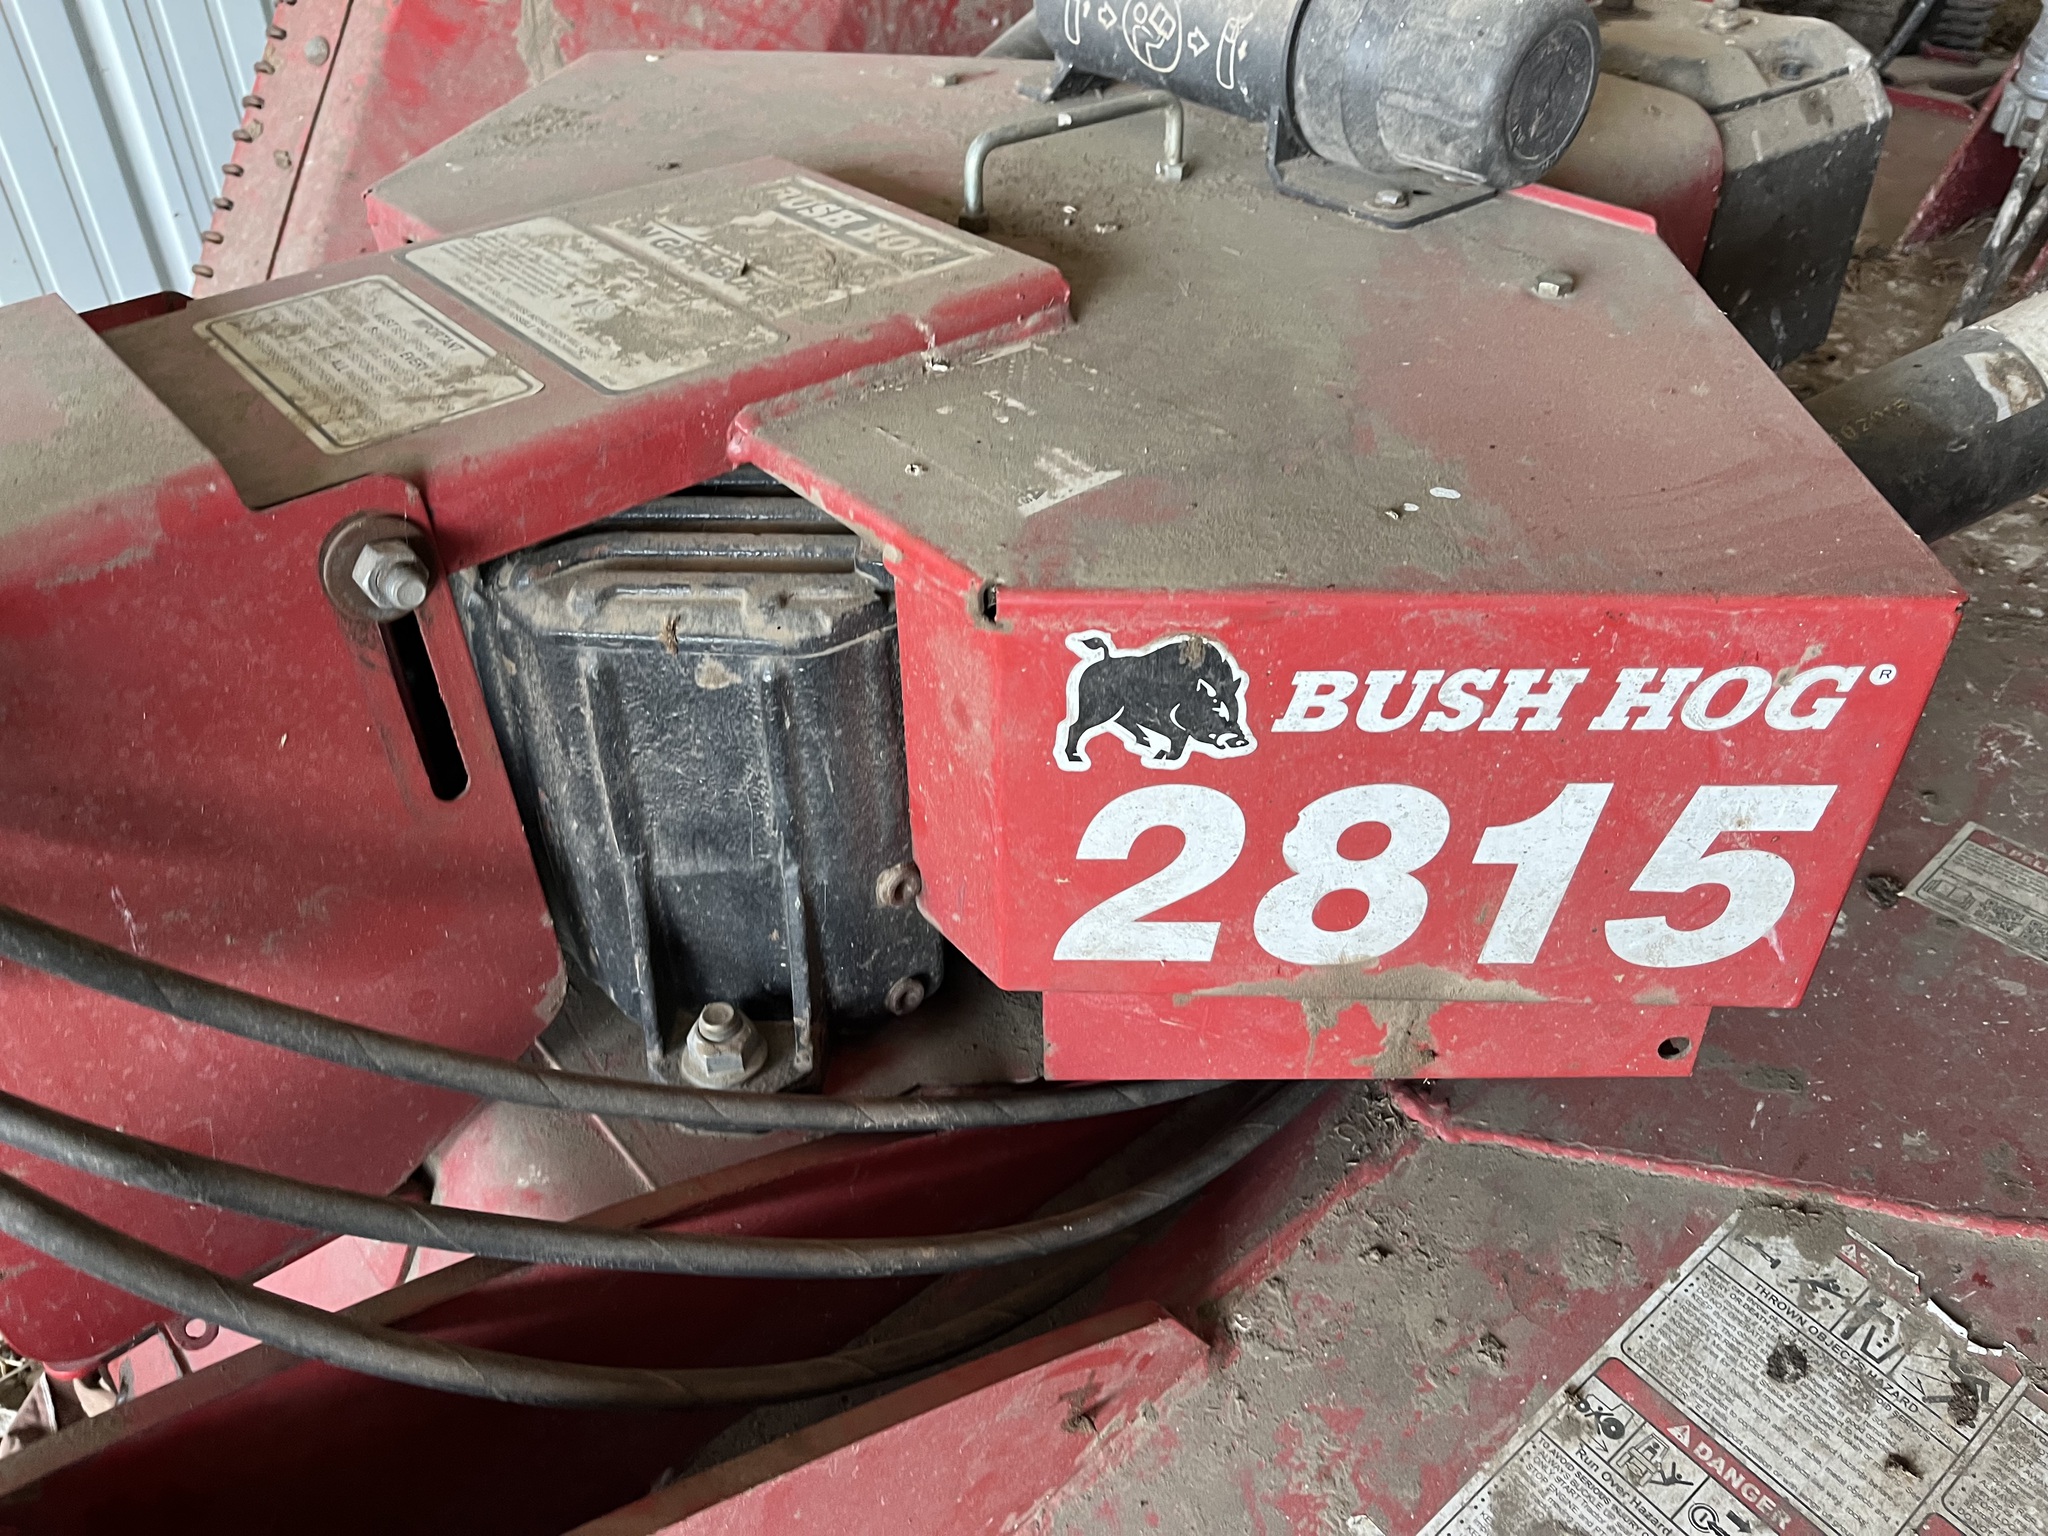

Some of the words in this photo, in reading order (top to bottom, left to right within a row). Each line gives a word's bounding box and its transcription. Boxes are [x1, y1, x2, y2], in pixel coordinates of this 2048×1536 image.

[1271, 666, 1591, 735] BUSH
[1588, 665, 1868, 732] HOG
[1052, 782, 1838, 969] 2815
[1689, 1292, 1713, 1312] KEEP
[1710, 1309, 1736, 1331] thrown
[1734, 1329, 1761, 1351] object
[1695, 1287, 1709, 1299] DO
[1707, 1296, 1727, 1313] NOT
[1725, 1310, 1766, 1343] OPERATE
[1699, 1270, 1729, 1294] INJURY
[1728, 1292, 1743, 1305] OR
[1741, 1303, 1771, 1327] DEATH
[1632, 1351, 1648, 1365] DO
[1645, 1362, 1664, 1379] NOT
[1644, 1338, 1659, 1352] DO
[1657, 1349, 1677, 1367] NOT
[1678, 1304, 1711, 1331] REPAIR
[1708, 1327, 1724, 1341] OR
[1721, 1338, 1761, 1371] REPLACE
[1730, 1284, 1746, 1297] can
[1744, 1295, 1769, 1316] throw
[1891, 1409, 1931, 1442] SERIOUS
[1752, 1282, 1808, 1327] THROWN
[1806, 1324, 1866, 1372] OBJECTS
[1865, 1370, 1920, 1414] HAZARD
[1700, 1363, 1727, 1386] AVOID
[1524, 1462, 1548, 1485] STOP
[1546, 1483, 1580, 1514] ENGINE
[1531, 1455, 1555, 1477] ONLY
[1553, 1475, 1581, 1501] START
[1537, 1437, 1551, 1450] TO
[1549, 1447, 1575, 1472] AVOID
[1573, 1470, 1611, 1505] SERIOUS
[1609, 1503, 1642, 1533] INJURY
[1537, 1449, 1571, 1480] ALWAYS
[1568, 1478, 1603, 1511] BUCKLE
[1601, 1508, 1616, 1522] UP
[1573, 1447, 1603, 1472] Run
[1598, 1470, 1632, 1499] Over
[1626, 1495, 1676, 1536] Hazard
[1689, 1440, 1795, 1530] DANGER
